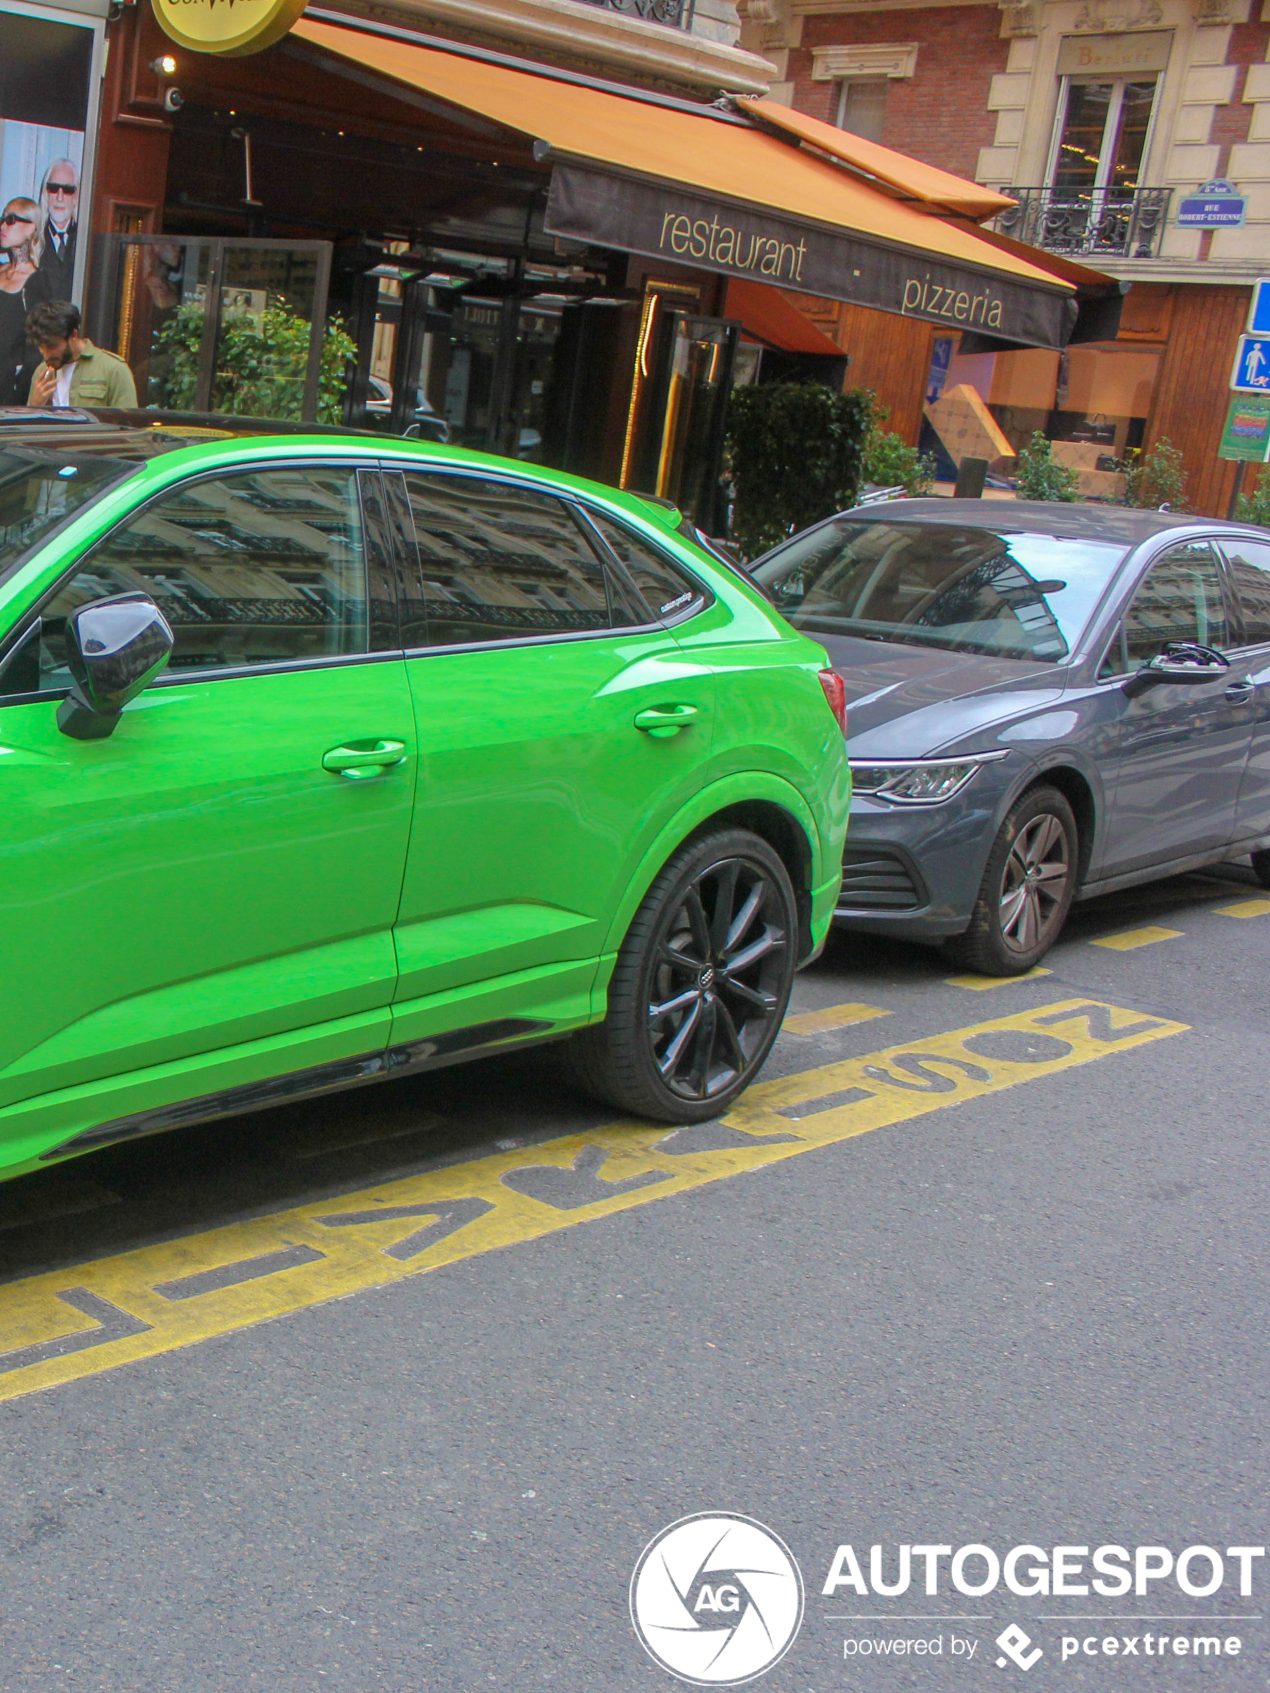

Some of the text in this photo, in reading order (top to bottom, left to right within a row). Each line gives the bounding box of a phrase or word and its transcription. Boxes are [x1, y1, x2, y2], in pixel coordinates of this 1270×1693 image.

[1178, 213, 1242, 221] ROBERT-ESTIENNE
[1204, 204, 1220, 212] RUE
[659, 212, 807, 281] restaurant
[901, 273, 1002, 329] pizzeria
